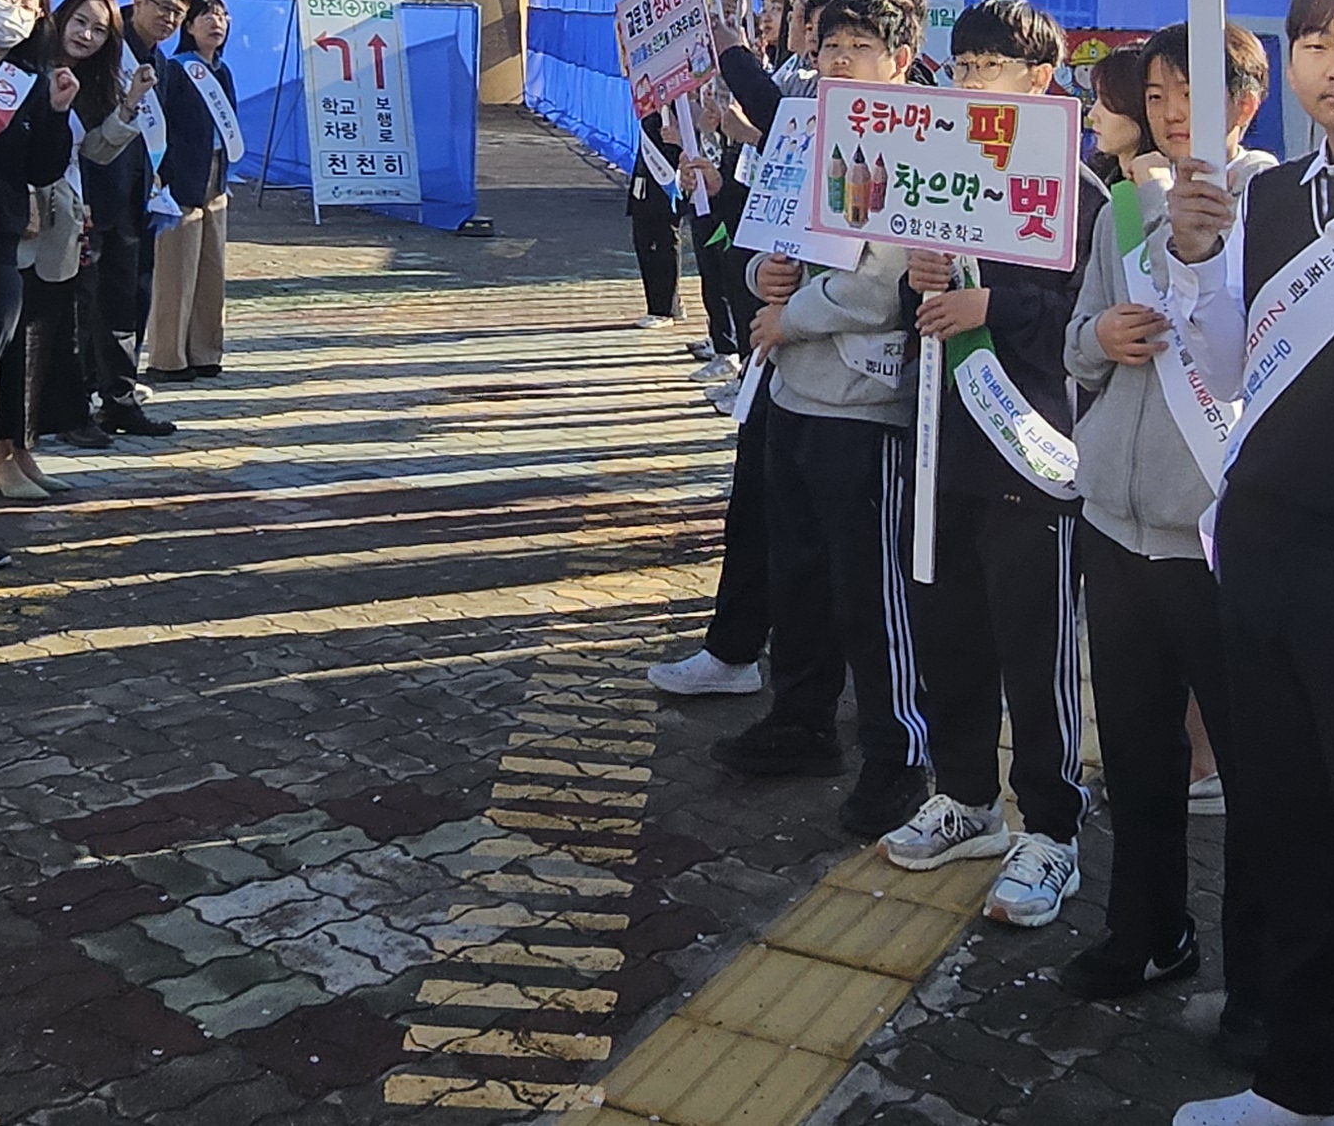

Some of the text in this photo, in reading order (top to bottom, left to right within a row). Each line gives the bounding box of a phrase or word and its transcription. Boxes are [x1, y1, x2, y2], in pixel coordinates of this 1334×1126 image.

[361, 0, 395, 20] 제일
[321, 96, 357, 116] 학교
[375, 96, 395, 143] 보행로
[324, 121, 358, 141] 차량
[967, 102, 1019, 171] 퍽
[745, 193, 799, 226] 로그아웃
[1007, 175, 1062, 243] 벗
[909, 218, 984, 243] 함안중학교
[1246, 299, 1288, 356] ZER
